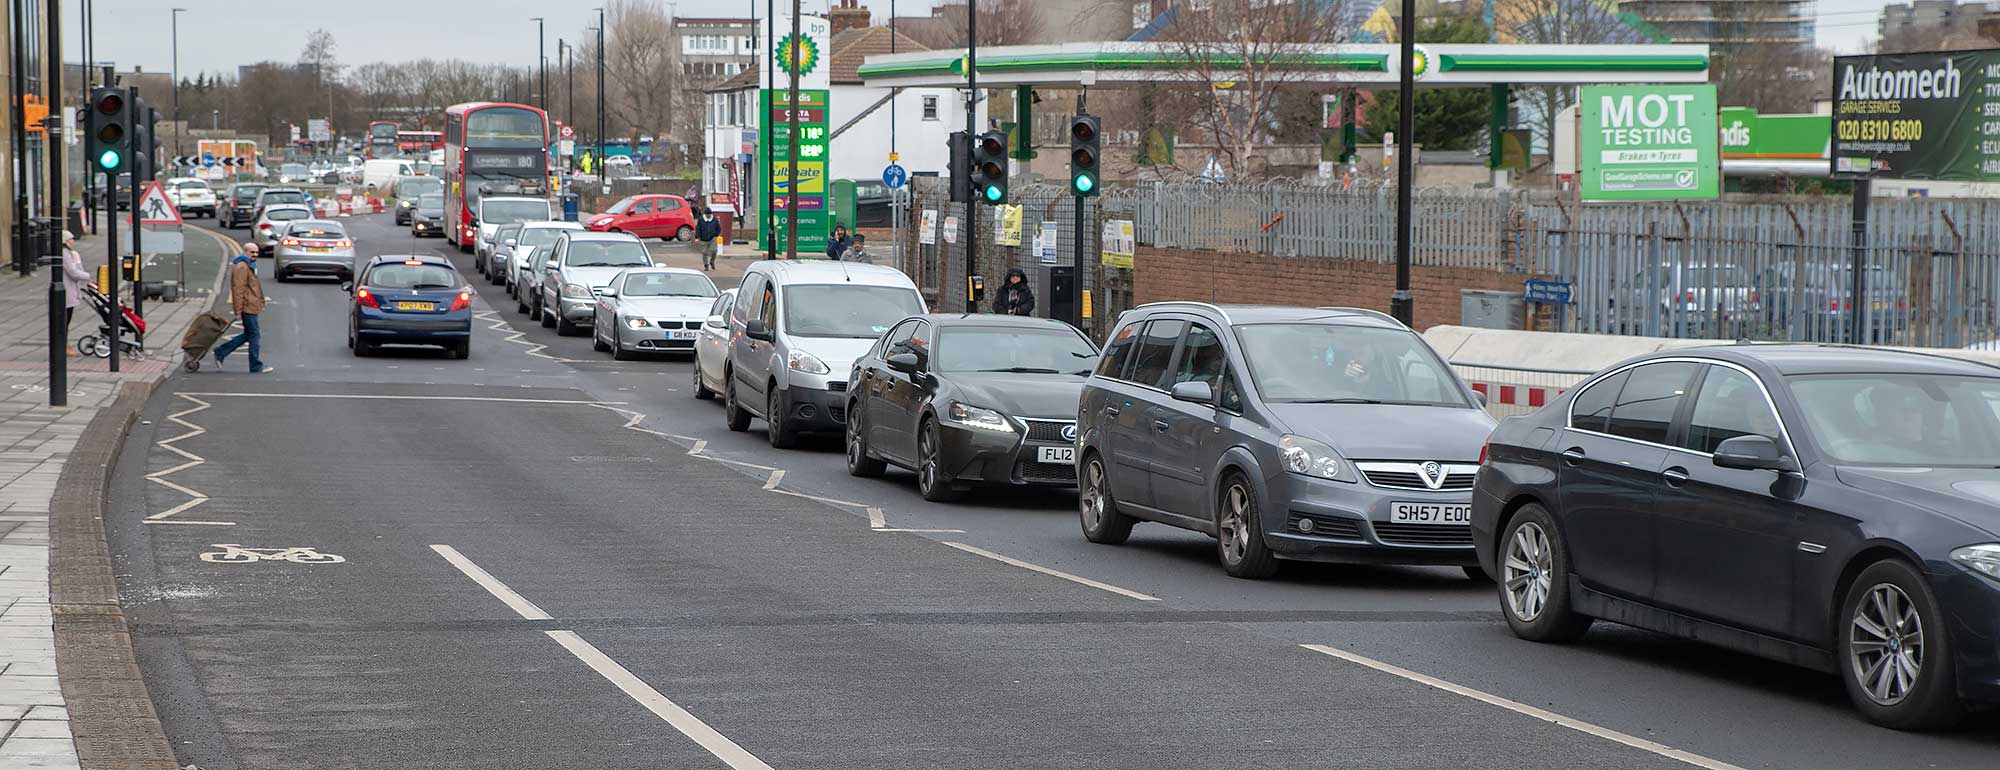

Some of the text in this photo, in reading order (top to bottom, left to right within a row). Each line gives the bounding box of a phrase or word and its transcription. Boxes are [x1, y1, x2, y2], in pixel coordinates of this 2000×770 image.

[811, 23, 824, 33] bp
[1840, 58, 1961, 100] Automech
[1601, 94, 1694, 128] MOT
[1840, 100, 1900, 113] GARAGE SERVICES
[1601, 128, 1692, 145] TESTING
[1721, 120, 1750, 146] ndis
[1839, 119, 1922, 140] 020 8310 6800
[518, 156, 533, 169] 180
[1619, 152, 1648, 161] Brakes
[1660, 151, 1682, 162] Tyres
[1045, 448, 1072, 461] FL12
[1398, 505, 1440, 521] SH57
